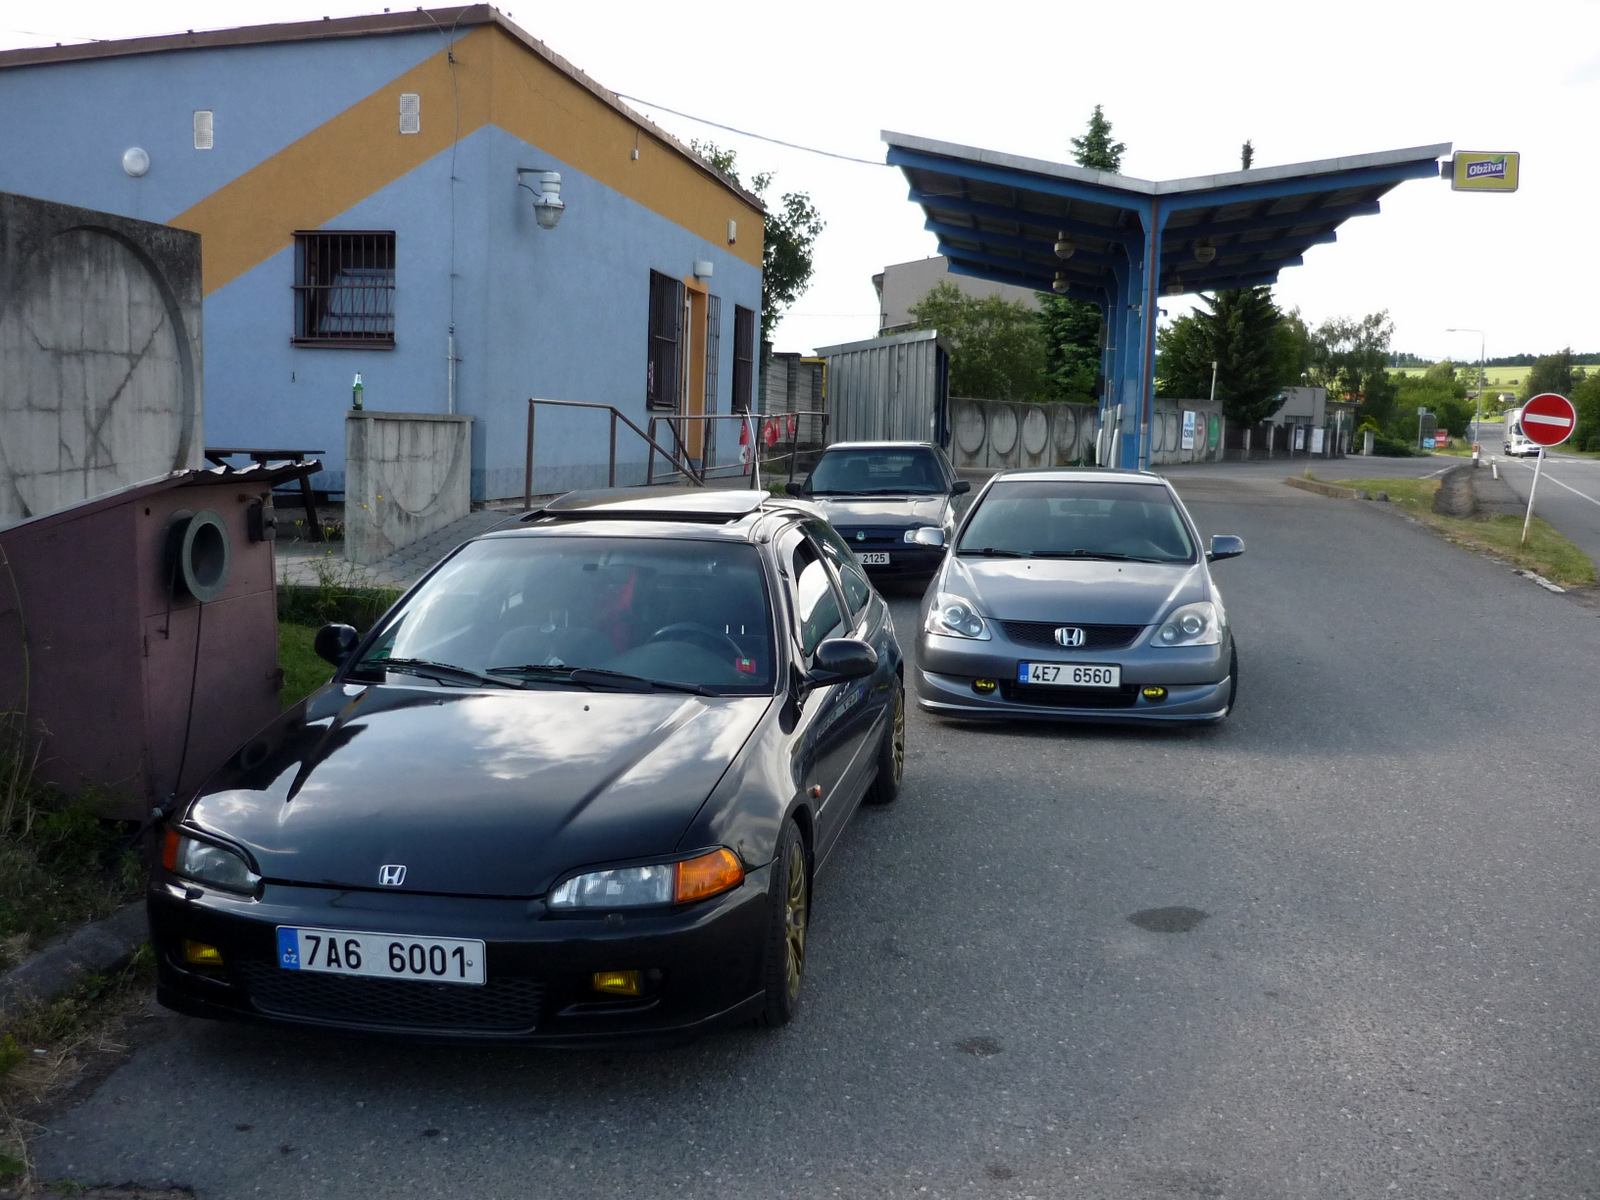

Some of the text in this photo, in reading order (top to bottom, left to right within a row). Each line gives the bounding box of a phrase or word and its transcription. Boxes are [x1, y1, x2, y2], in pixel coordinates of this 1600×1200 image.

[1469, 162, 1502, 175] Obživa
[863, 554, 885, 563] 2125
[1032, 666, 1112, 684] 4E7 6560
[283, 953, 297, 964] CZ
[305, 935, 465, 977] 7A6 6001
